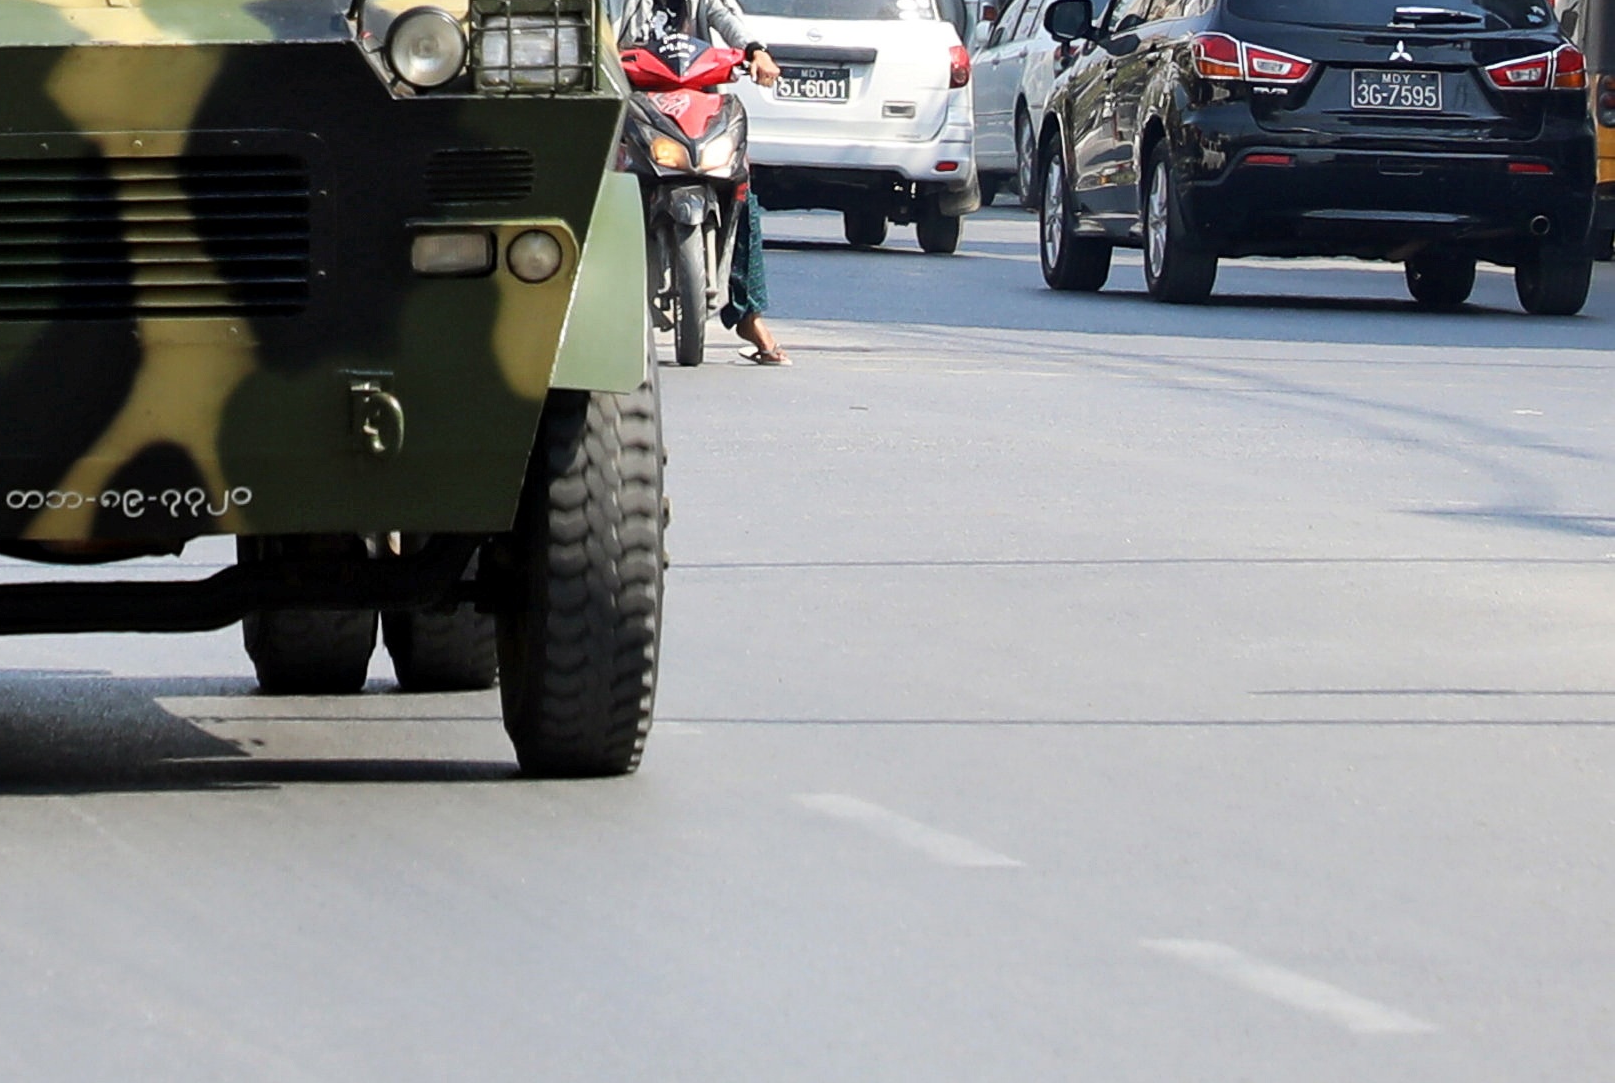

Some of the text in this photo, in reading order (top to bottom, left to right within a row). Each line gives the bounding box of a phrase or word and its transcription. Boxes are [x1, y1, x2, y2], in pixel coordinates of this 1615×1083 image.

[800, 69, 825, 78] MDY
[1382, 73, 1411, 84] MDY
[1357, 83, 1437, 107] 3G-7595
